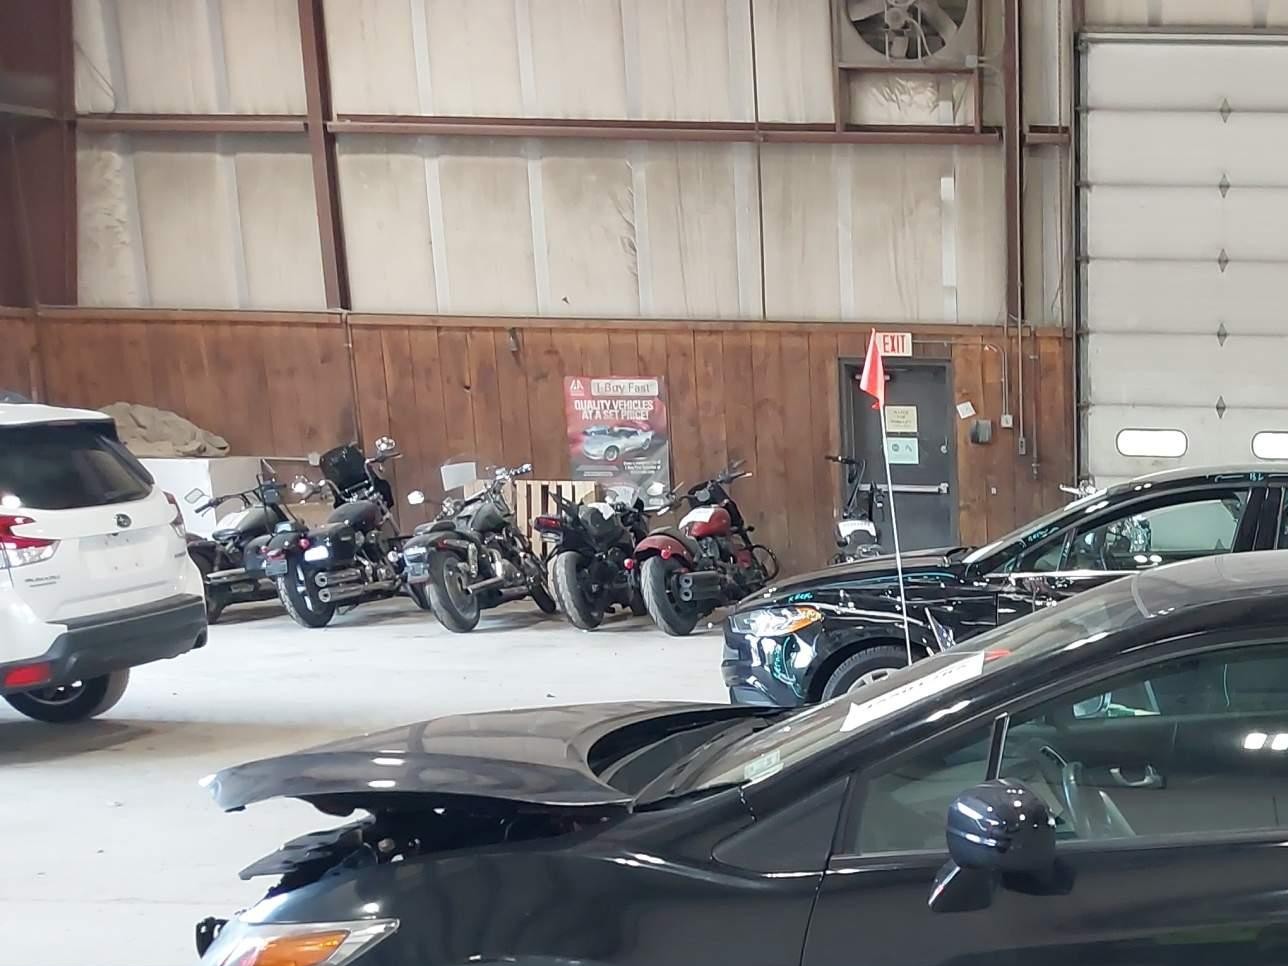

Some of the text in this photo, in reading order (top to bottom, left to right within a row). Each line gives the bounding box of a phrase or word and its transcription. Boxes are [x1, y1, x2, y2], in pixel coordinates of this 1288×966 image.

[882, 334, 907, 354] EXIT
[628, 382, 651, 393] Fast
[574, 399, 654, 411] QUALITY VEHICLES
[582, 410, 649, 421] AT A SET PRICE!
